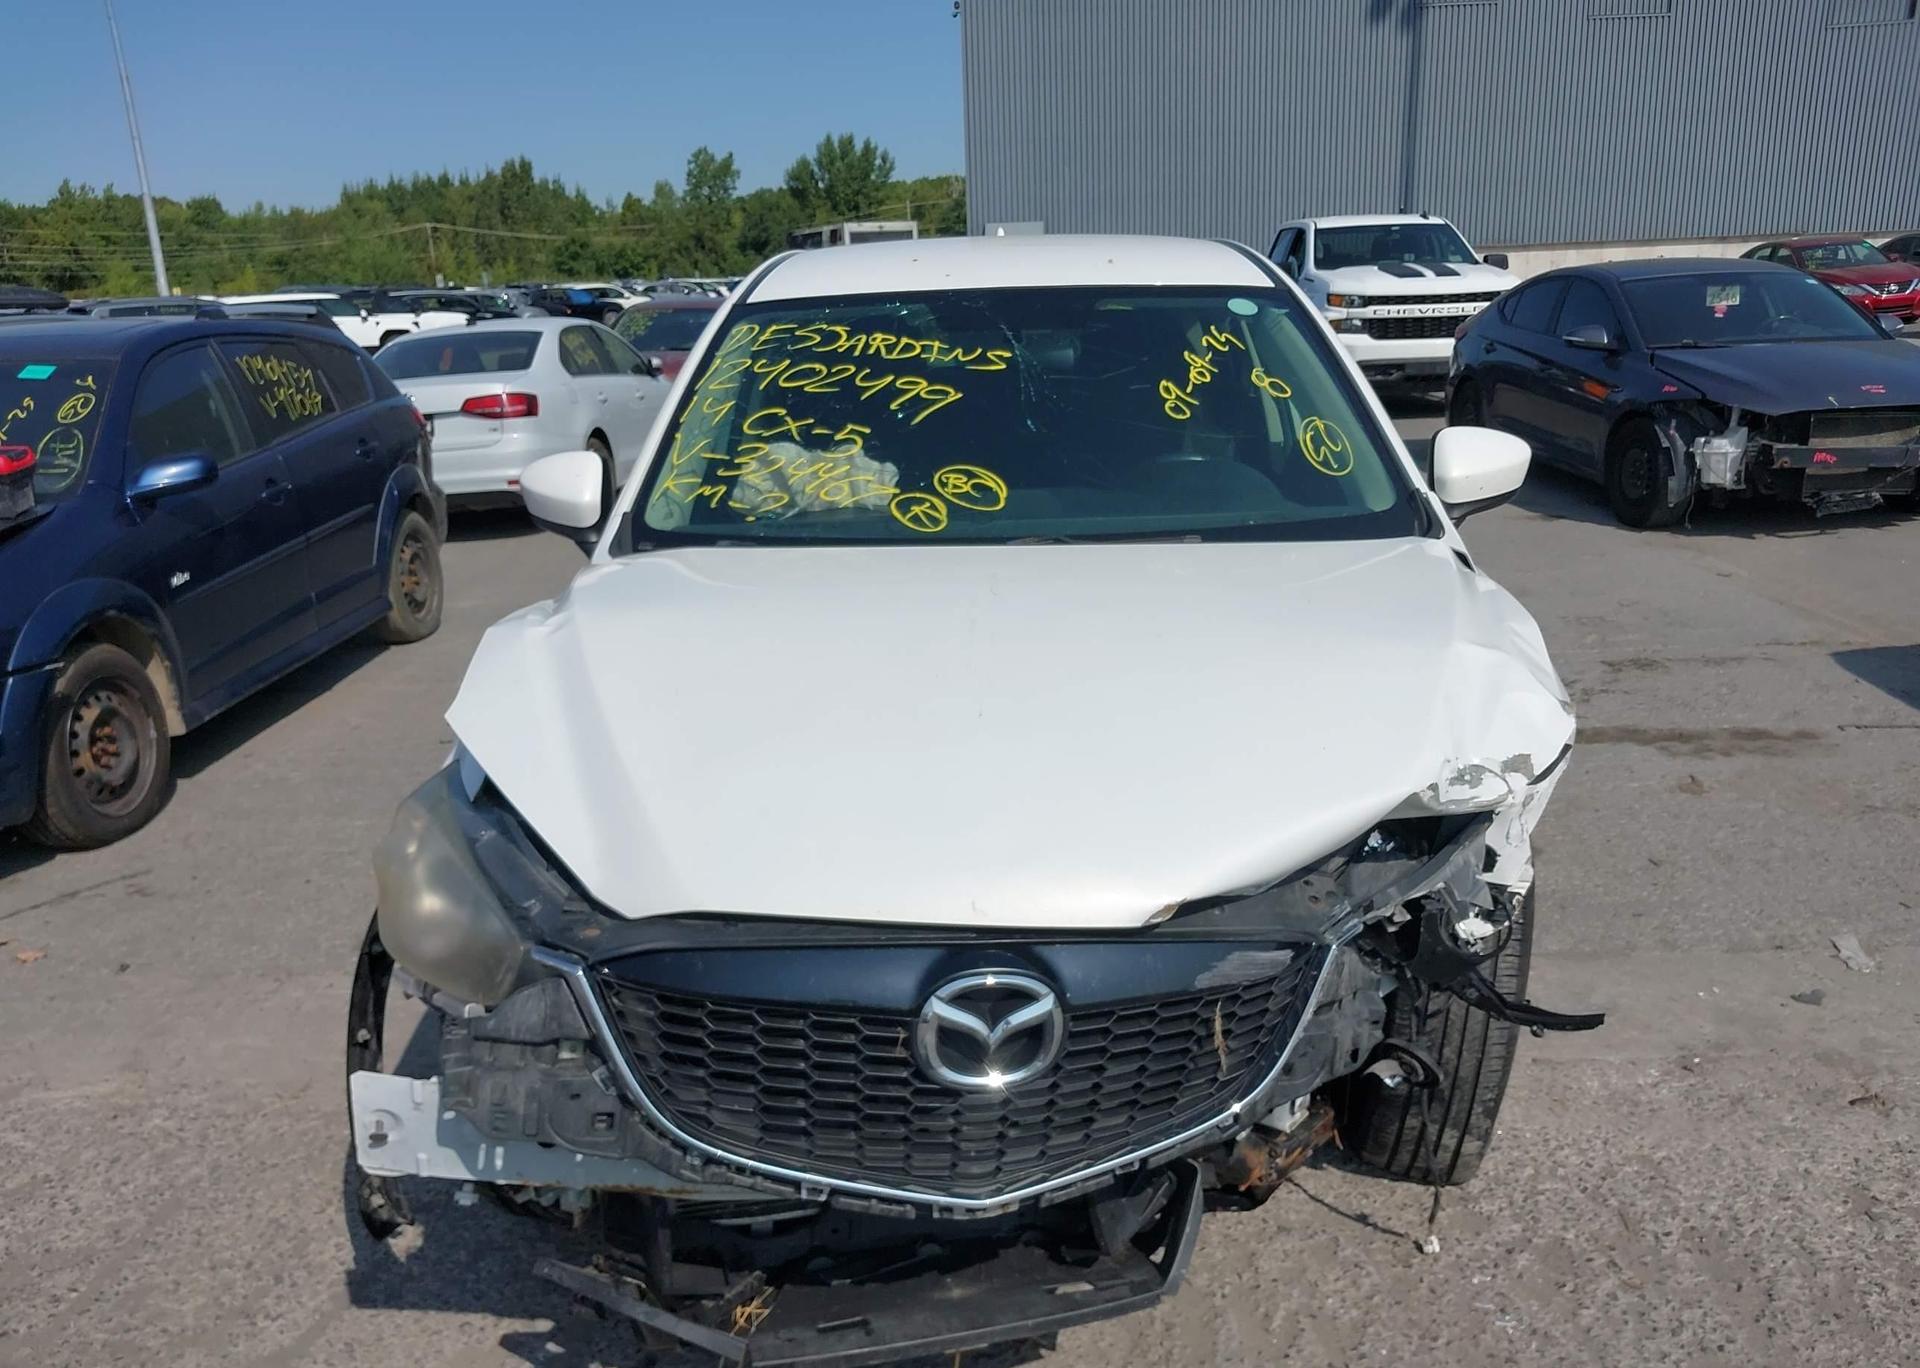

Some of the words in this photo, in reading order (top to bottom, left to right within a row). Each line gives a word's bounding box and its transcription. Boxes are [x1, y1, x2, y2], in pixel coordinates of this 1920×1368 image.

[1373, 306, 1485, 316] CHEVROLE
[716, 323, 1013, 371] DESJARDINS
[694, 354, 964, 426] 12402499
[679, 396, 736, 425] 14
[742, 408, 873, 457] CX-5
